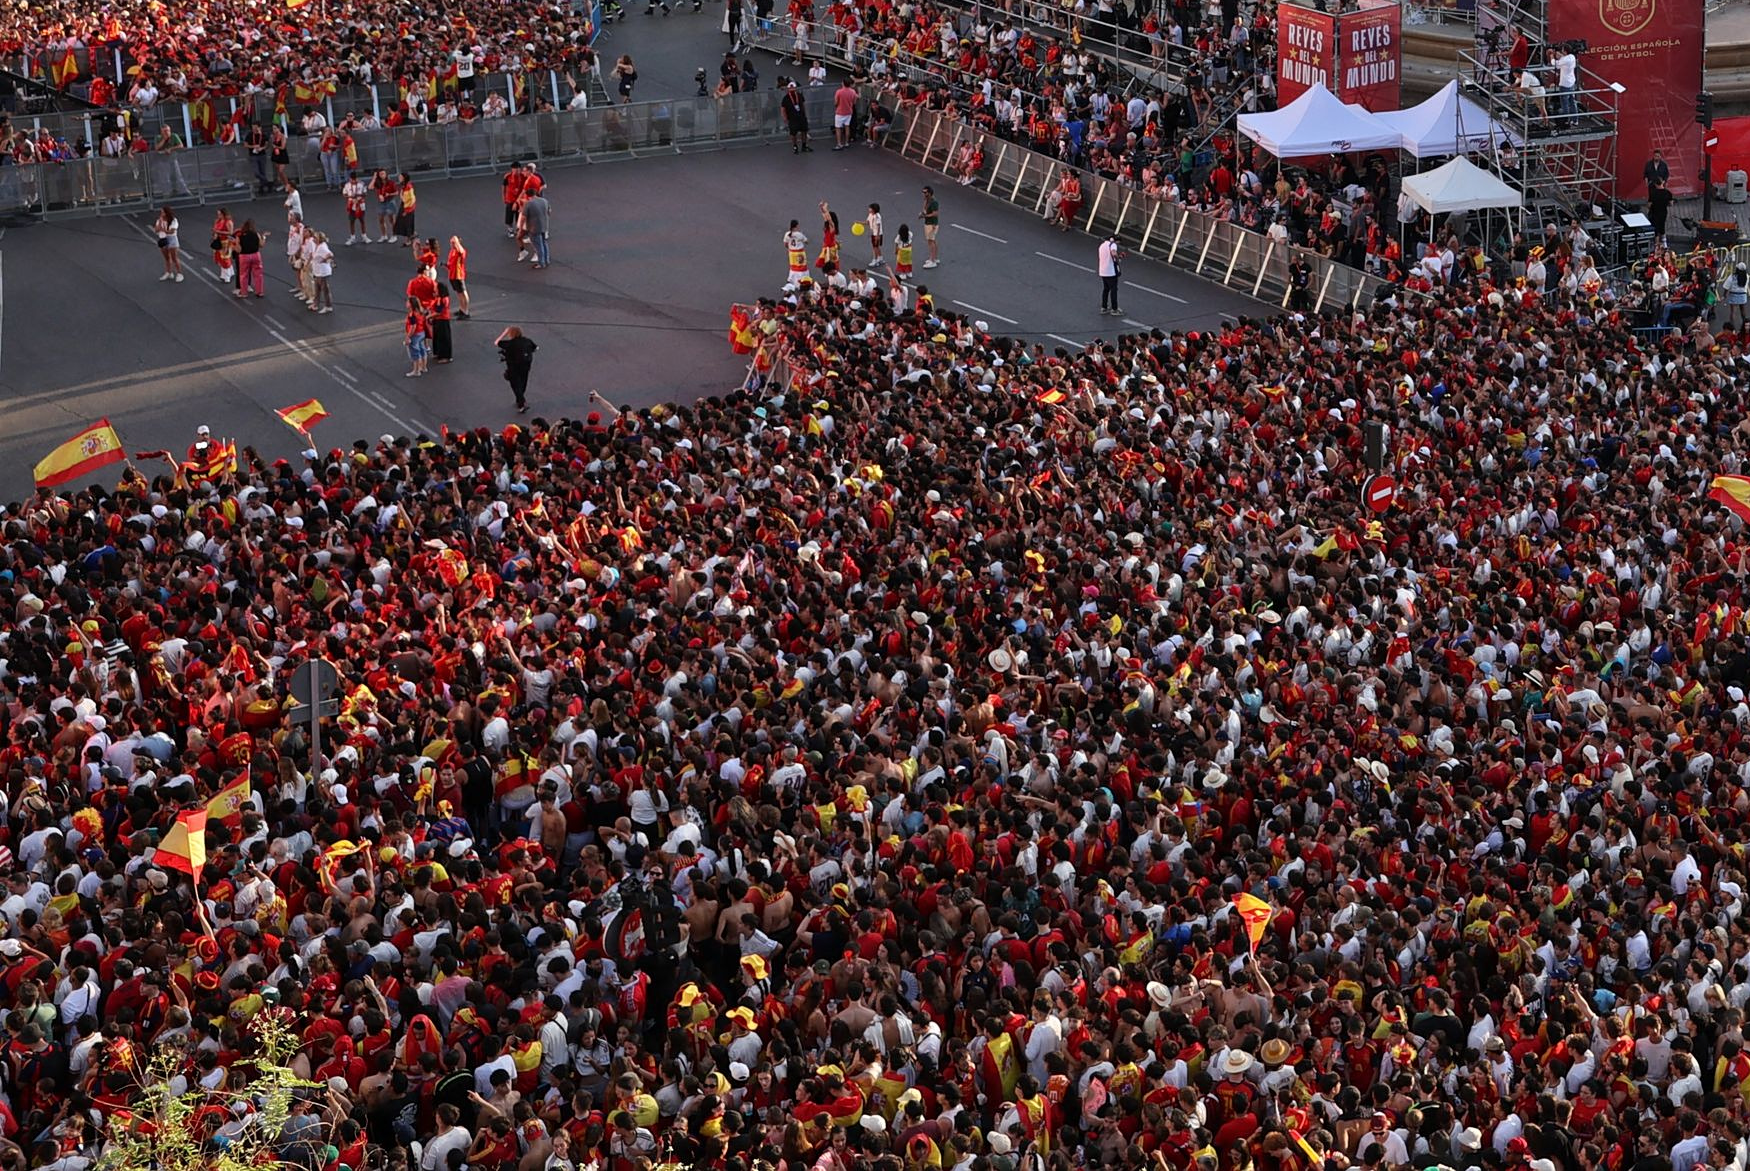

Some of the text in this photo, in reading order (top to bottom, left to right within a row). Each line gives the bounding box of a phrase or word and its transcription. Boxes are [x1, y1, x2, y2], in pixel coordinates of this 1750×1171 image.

[1288, 23, 1323, 53] REYES
[1352, 24, 1391, 52] REYES
[1630, 38, 1681, 50] ESPAÑOLA
[1299, 49, 1310, 64] DEL
[1364, 49, 1377, 63] DEL
[1601, 49, 1655, 61] DE FÚTBOL
[458, 61, 470, 71] 20
[1282, 58, 1327, 87] MUNDO
[1346, 59, 1395, 89] MUNDO
